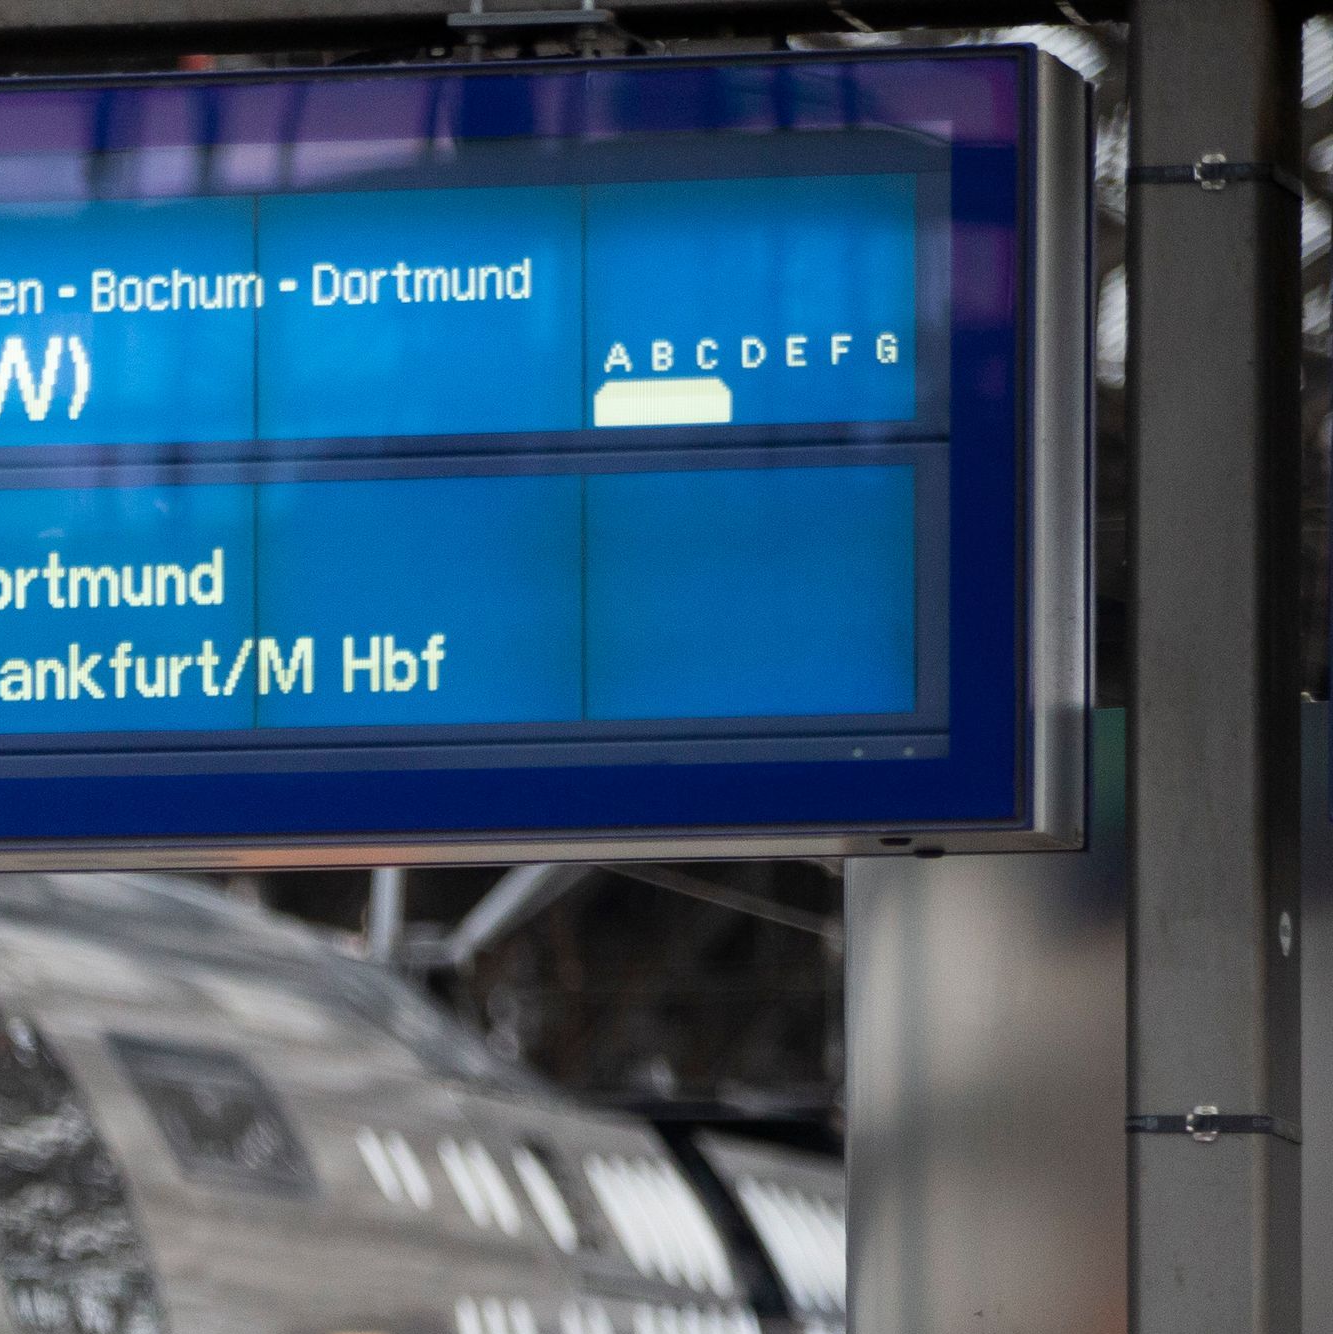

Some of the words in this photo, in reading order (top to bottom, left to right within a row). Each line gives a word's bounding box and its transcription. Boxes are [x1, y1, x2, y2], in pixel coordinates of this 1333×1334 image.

[91, 267, 264, 313] Bochum
[311, 256, 532, 307] Dortmund
[603, 342, 633, 374] A
[651, 340, 674, 372] B
[696, 338, 719, 371] C
[740, 337, 767, 369] D
[785, 335, 809, 368] E
[830, 334, 853, 366] F
[875, 332, 899, 364] G
[342, 633, 446, 694] Hbf
